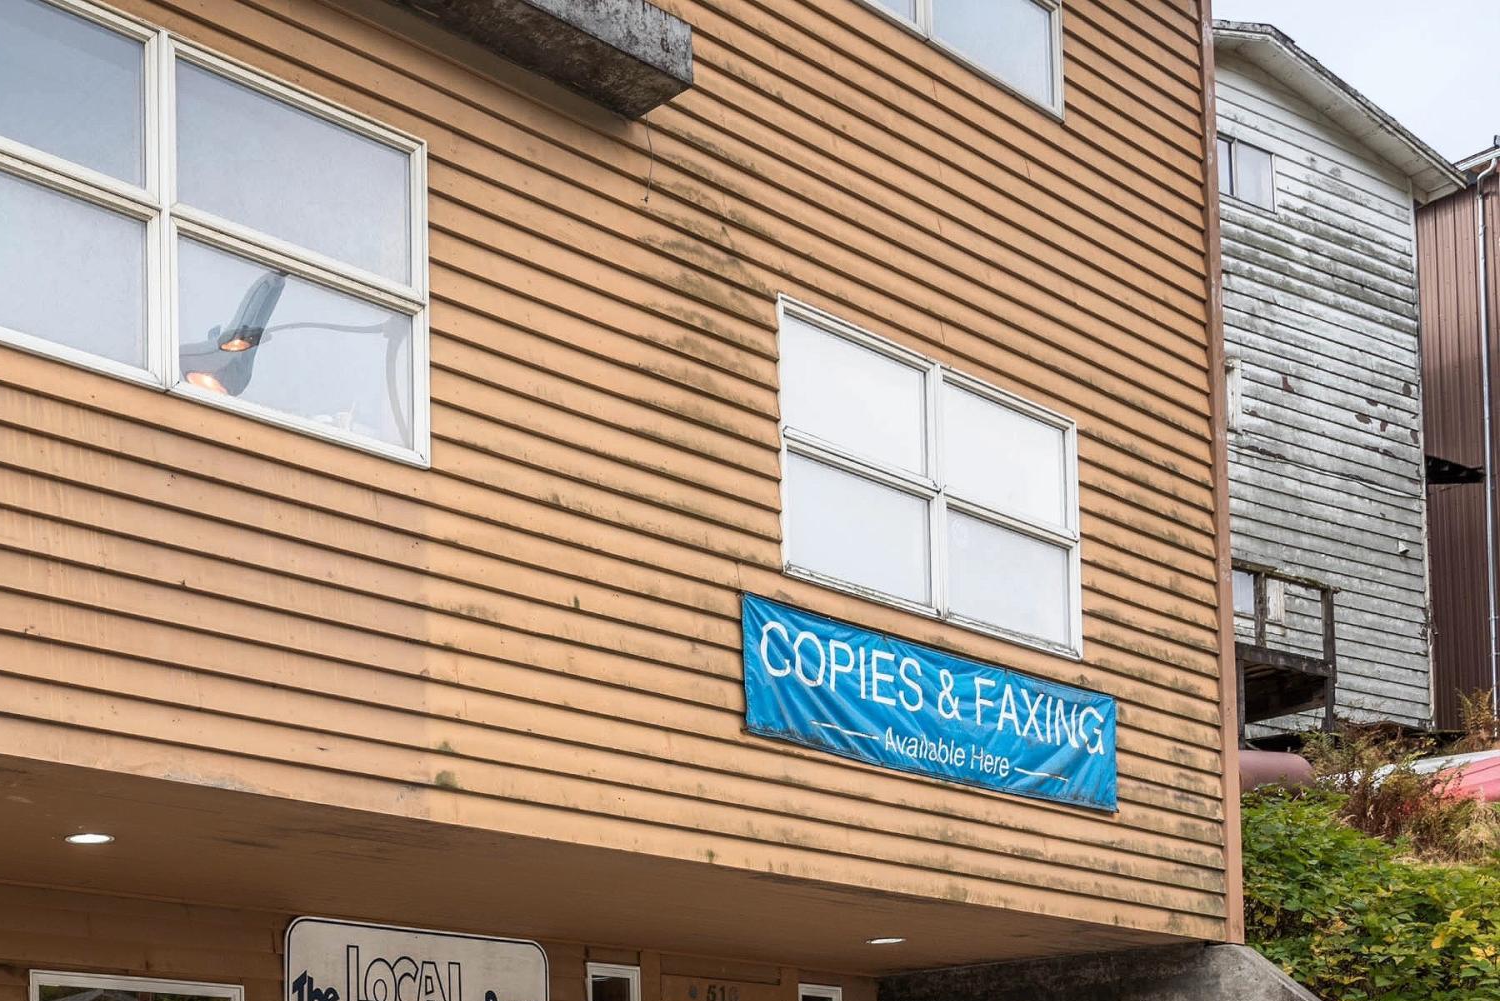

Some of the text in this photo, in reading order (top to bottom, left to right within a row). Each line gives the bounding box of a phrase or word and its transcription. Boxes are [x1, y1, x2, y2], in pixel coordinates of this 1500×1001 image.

[760, 621, 1105, 755] COPIES & FAXING
[884, 727, 1010, 778] Available Here
